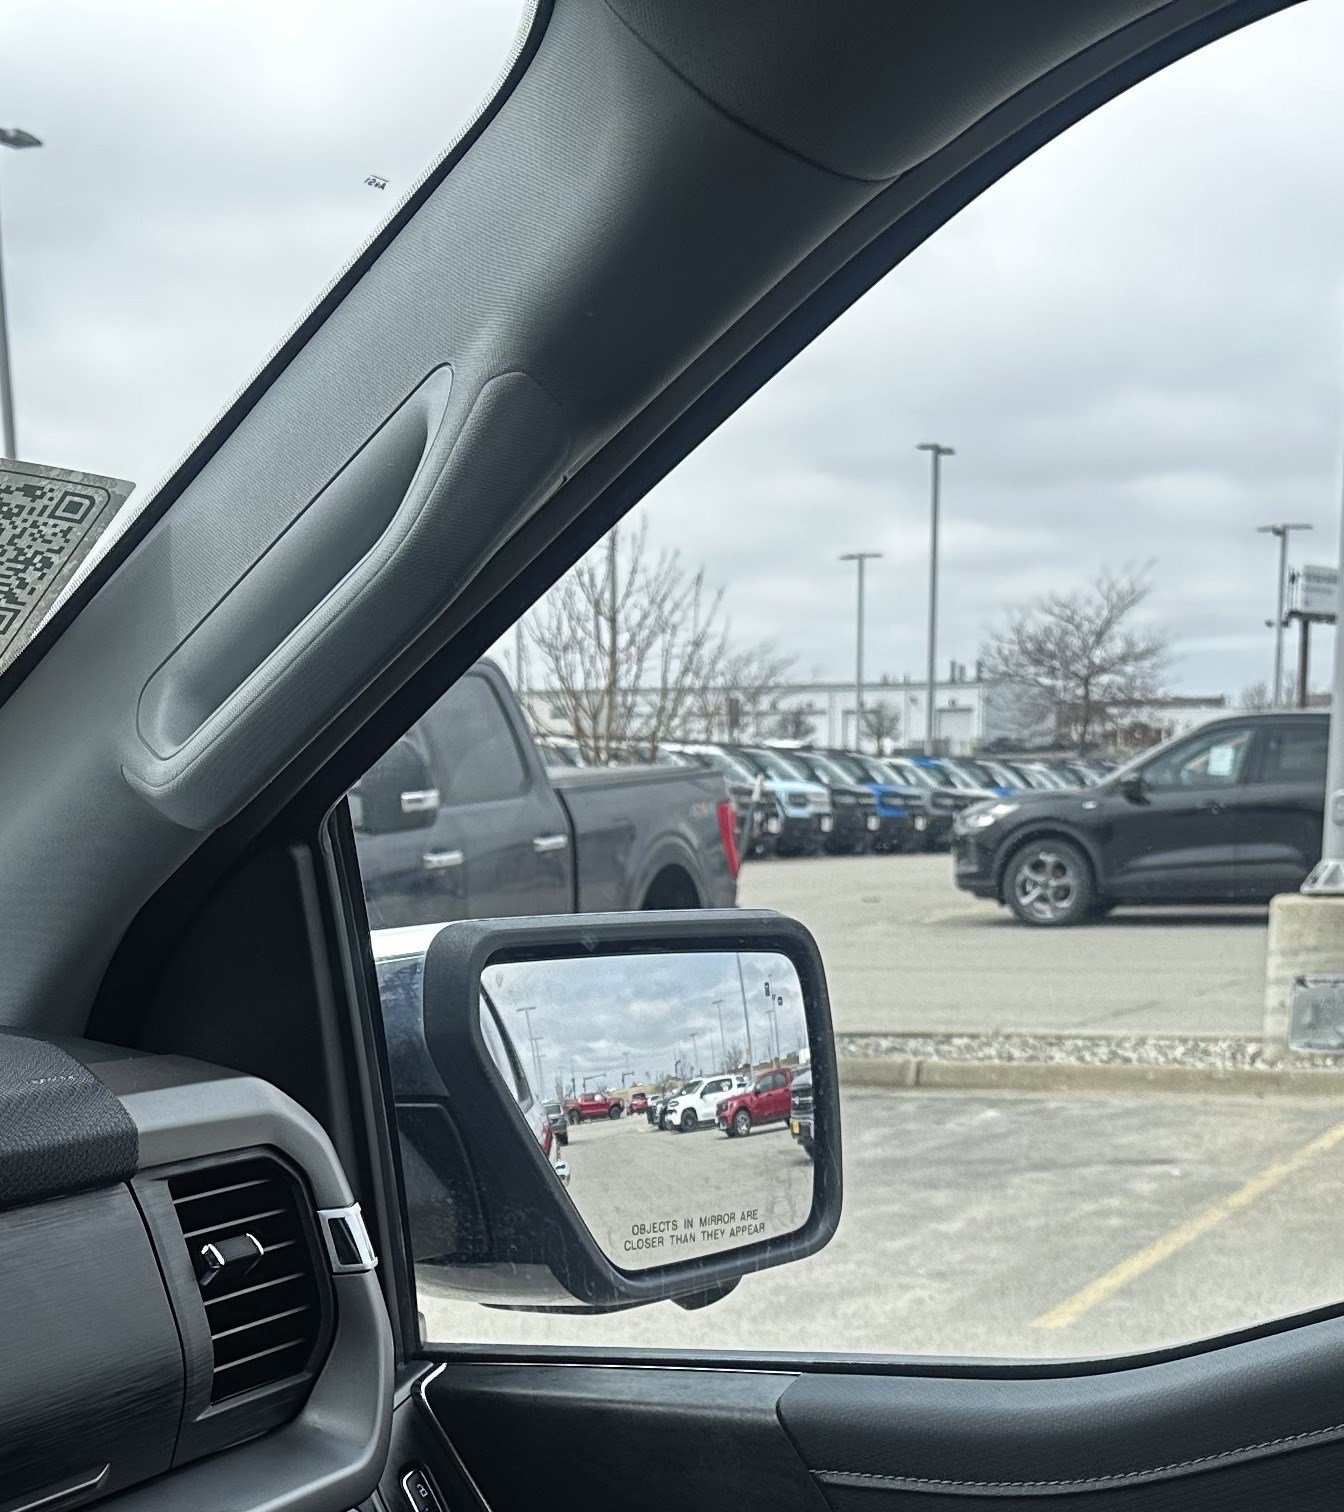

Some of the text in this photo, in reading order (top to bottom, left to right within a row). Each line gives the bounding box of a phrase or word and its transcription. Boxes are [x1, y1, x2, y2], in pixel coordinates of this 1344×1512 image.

[632, 1209, 758, 1236] OBJECTS IN MIRROR ARE
[624, 1222, 766, 1252] CLOSER THAN THEY APPEAR
